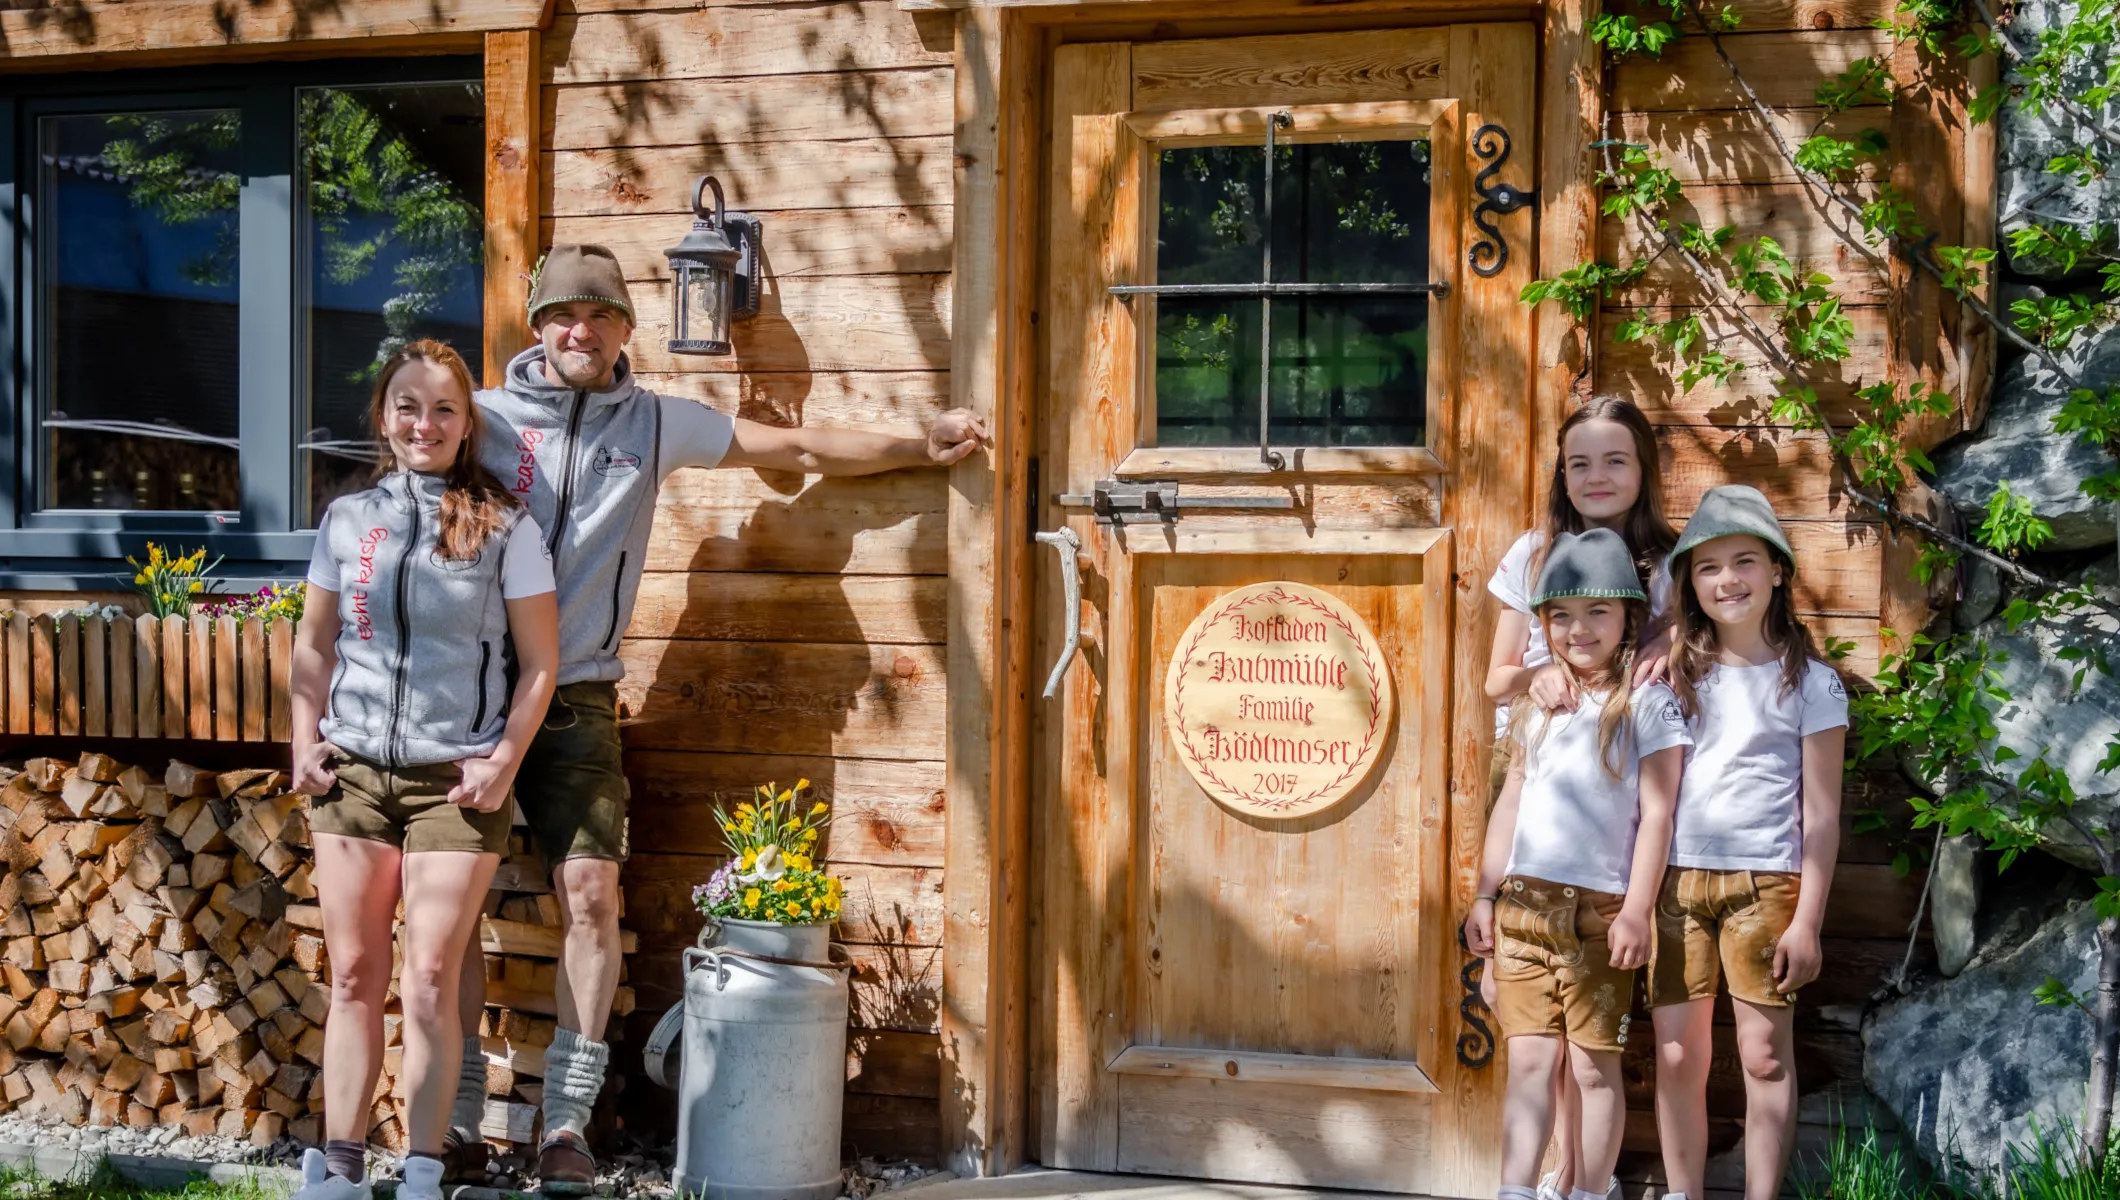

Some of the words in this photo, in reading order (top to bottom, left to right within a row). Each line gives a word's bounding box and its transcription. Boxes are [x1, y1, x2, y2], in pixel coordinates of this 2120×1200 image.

[1229, 614, 1328, 645] Hofladen
[1207, 651, 1349, 690] Hubmühle
[1238, 694, 1315, 724] Familie
[1202, 729, 1352, 766] Hödlmoser
[1252, 773, 1298, 795] 2017
